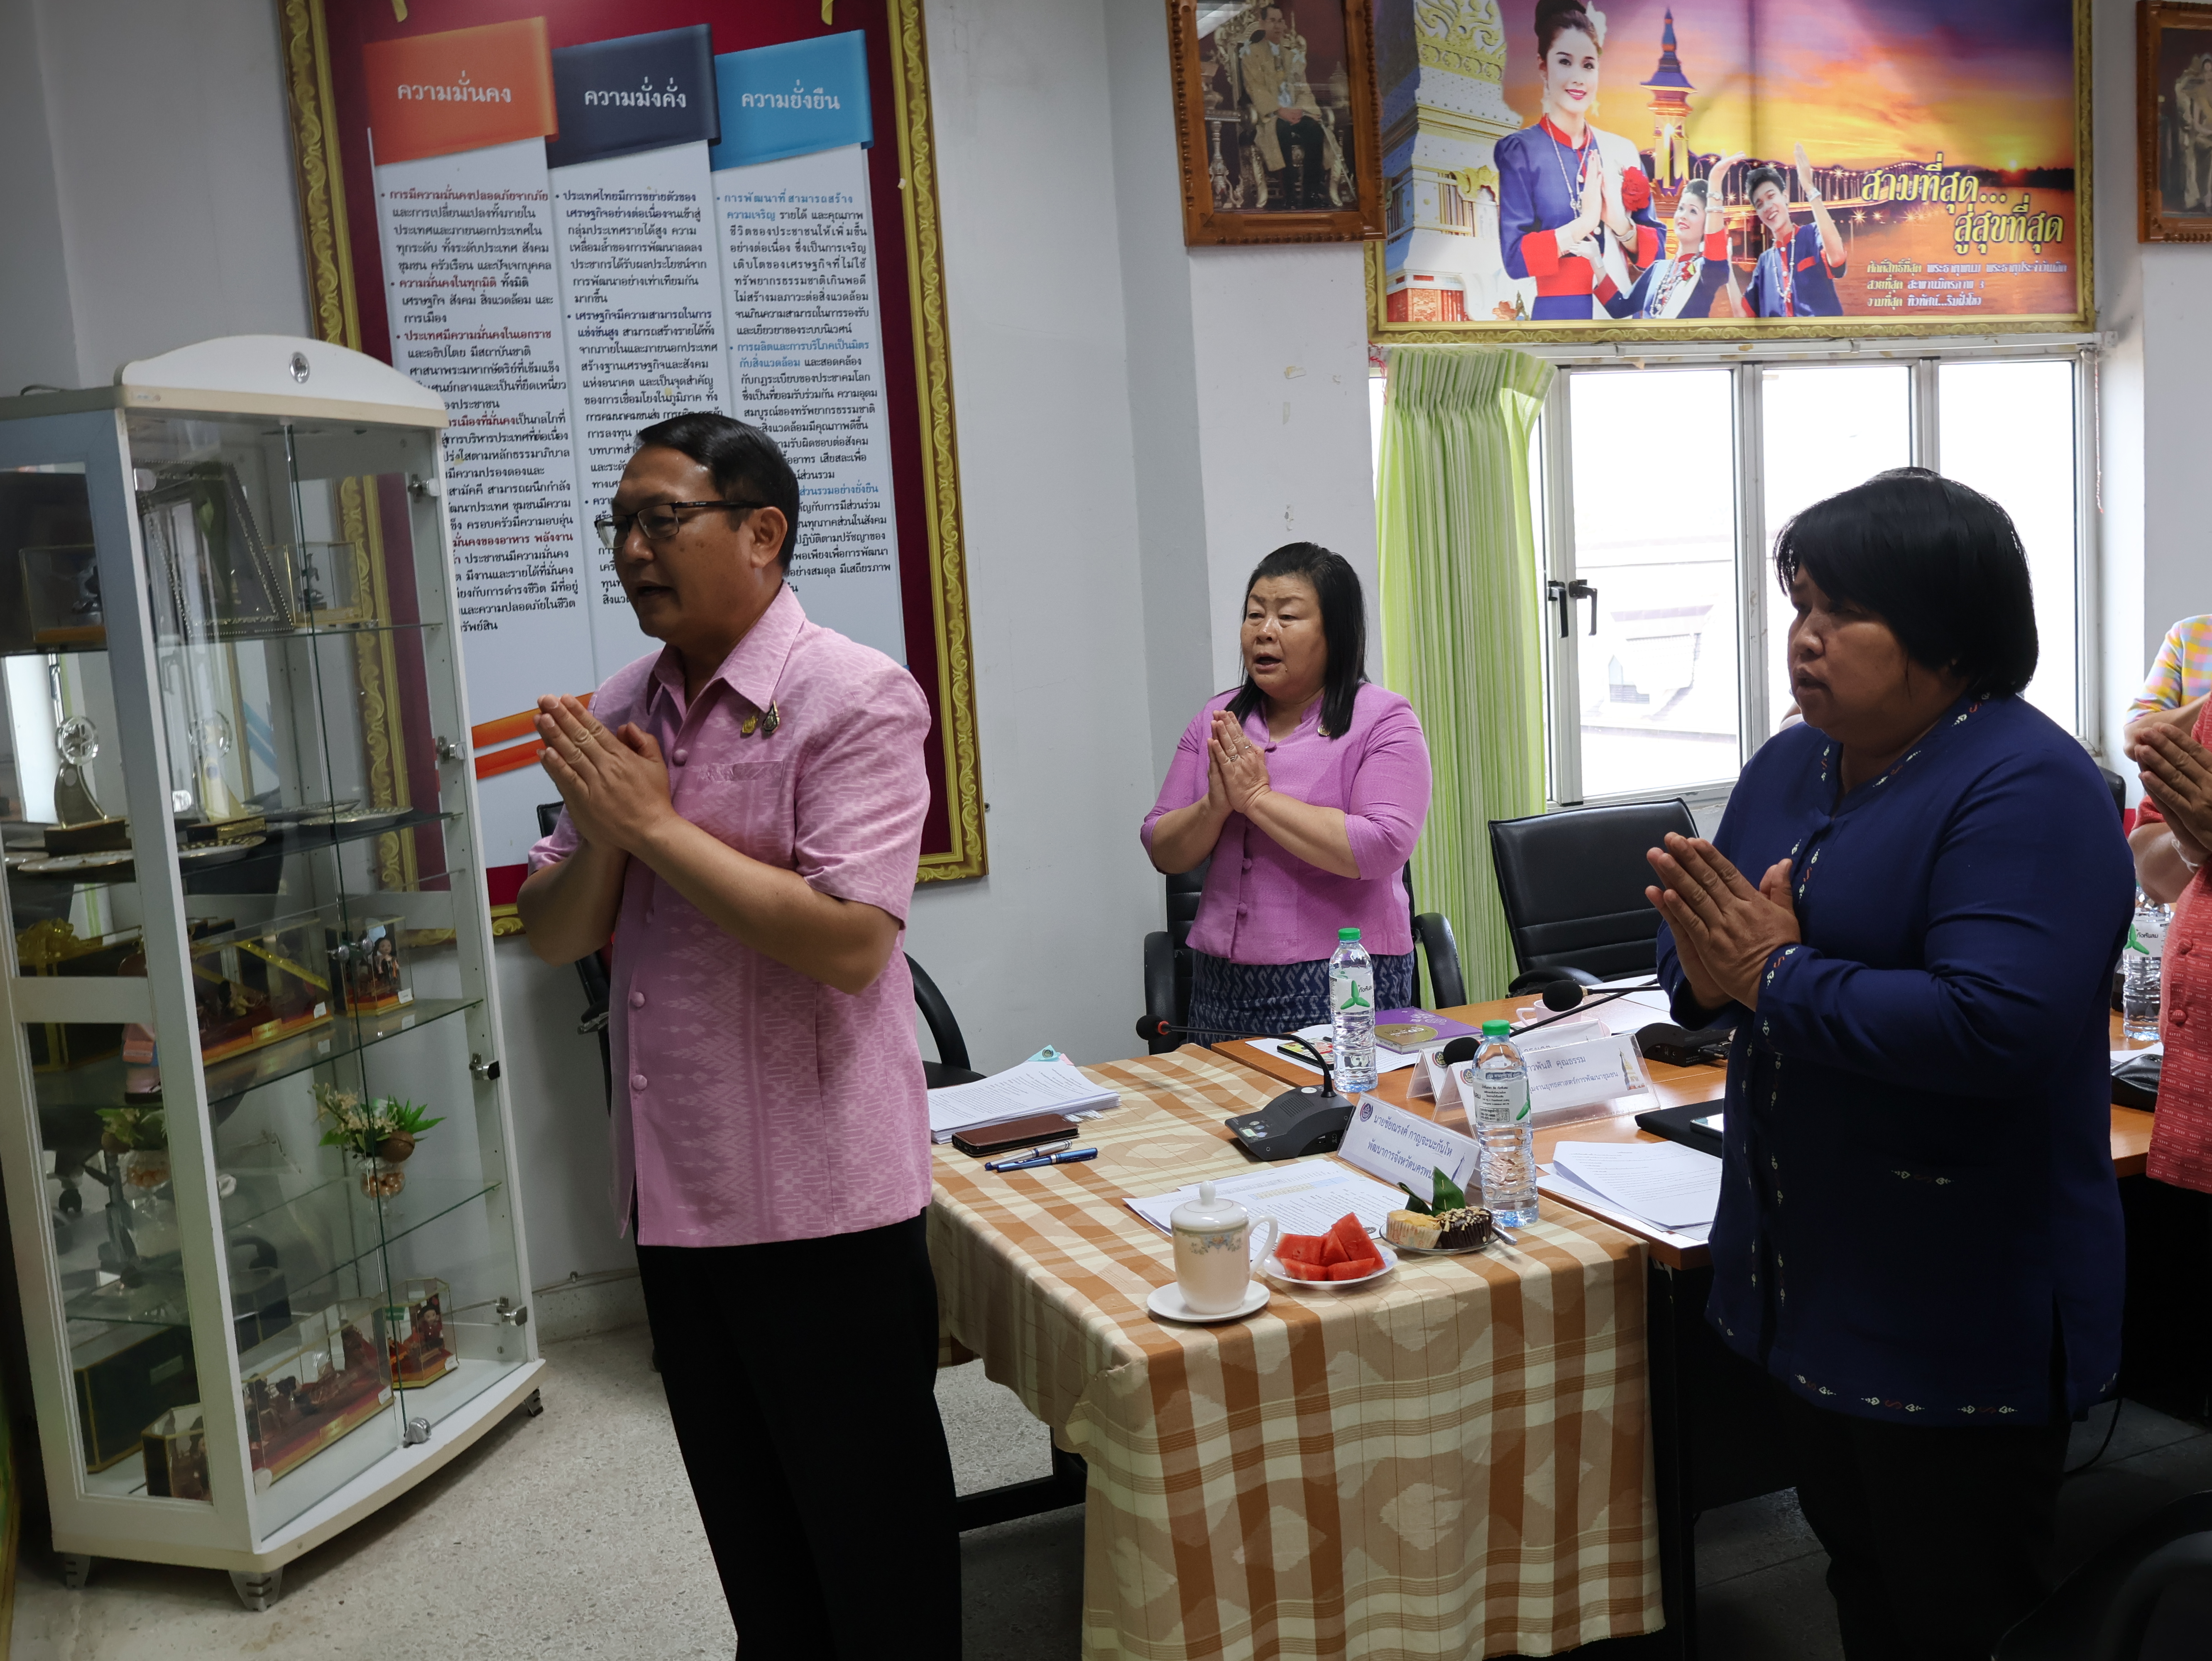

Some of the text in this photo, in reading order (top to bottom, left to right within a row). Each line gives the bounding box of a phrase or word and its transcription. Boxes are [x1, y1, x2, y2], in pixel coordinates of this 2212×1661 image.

[397, 71, 511, 104] ความมั่นคง
[585, 77, 687, 109] ความมั่งคั่ง
[742, 80, 840, 110] ความยั่งยืน
[390, 184, 548, 200] การมีความมั่นคงปลอดภัยจากภัย
[393, 203, 535, 218] และการเปลี่ยนแปลงทั้งภายใน
[567, 203, 701, 222] เศรษฐกิจอย่างต่อเนื่องจนเข้าสู่
[727, 207, 863, 223] ความเจริญ รายได้ และคุณภาพ
[394, 223, 542, 236] ประเทศและภายนอกประเทศใน
[568, 223, 667, 239] กลุ่มประเทศรายได้สูง
[1954, 194, 2064, 255] สู่สุขที่สุด
[396, 238, 549, 255] ทุกระดับ ทั้งระดับประเทศ สังคม
[570, 237, 702, 252] เหลื่อมล้ำของการพัฒนาลดลง
[730, 238, 866, 254] อย่างต่อเนื่อง ซึ่งเป็นการเจริญ
[398, 258, 552, 274] ชุมชน ครัวเรือน และปัจเจกบุคคล
[571, 256, 707, 269] ประชากรได้รับผลประโยชน์จาก
[400, 272, 529, 291] ความมั่นคงในทุกมิติ ทั้งมิติ
[573, 274, 698, 286] การพัฒนาอย่างเท่าเทียมกัน
[734, 274, 866, 286] ทรัพยากรธรรมชาติเกินพอดี
[403, 294, 445, 308] เศรษฐกิจ
[450, 294, 476, 305] สังคม
[480, 289, 531, 305] สิ่งแวดล้อม
[575, 288, 607, 303] มากขึ้น
[734, 287, 869, 302] ไม่สร้างมลภาวะต่อสิ่งแวดล้อม
[404, 311, 446, 323] การเมือง
[576, 306, 712, 323] เศรษฐกิจมีความสามารถในการ
[735, 306, 869, 318] จนเกินความสามารถในการรองรับ
[404, 324, 551, 341] ประเทศมีความมั่นคงในเอกราช
[578, 321, 714, 341] แข่งขันสูง สามารถสร้างรายได้ทั้ง
[737, 323, 852, 335] และเยียวยาของระบบนิเวศน์
[408, 345, 531, 358] และอธิปไตย มีสถาบันชาติ
[579, 341, 718, 355] จากภายในและภายนอกประเทศ
[738, 339, 869, 351] การผลิตและการบริโภคเป็นมิตร
[410, 358, 559, 375] ศาสนาพระมหากษัตริย์ที่เข้มแข็ง
[581, 358, 708, 374] สร้างฐานเศรษฐกิจและสังคม
[740, 353, 861, 367] กับสิ่งแวดล้อม และสอดคล้อง
[583, 375, 713, 390] แห่งอนาคต และเป็นจุดสำคัญ
[741, 370, 870, 386] กับกฎระเบียบของประชาคมโลก
[706, 390, 718, 401] ทั้ง
[742, 386, 877, 401] ซึ่งเป็นที่ยอมรับร่วมกัน ความอุดม
[586, 410, 660, 422] การคมนาคมขนส่ง
[744, 403, 875, 420] สมบูรณ์ของทรัพยากรธรรมชาติ
[587, 429, 632, 441] การลงทุน
[820, 448, 866, 463] เสียสละเพื่อ
[447, 479, 570, 496] สามัคคี สามารถผนึกกำลัง
[513, 498, 570, 513] ชุมชนมีความ
[467, 513, 573, 530] ครอบครัวมีความอบอุ่น
[534, 532, 573, 543] พลังงาน
[465, 544, 568, 564] ประชาชนมีความมั่นคง
[792, 544, 888, 561] พอเพียงเพื่อการพัฒนา
[466, 561, 573, 580] มีงานและรายได้ที่มั่นคง
[840, 562, 891, 574] มีเสถียรภาพ
[551, 576, 578, 594] มีที่อยู่
[459, 598, 575, 616] และความปลอดภัยในชีวิต
[1556, 1056, 1586, 1069] คุณธรรม
[1374, 1115, 1453, 1157] นายชัยณรงค์ กาญจะนะกันโห
